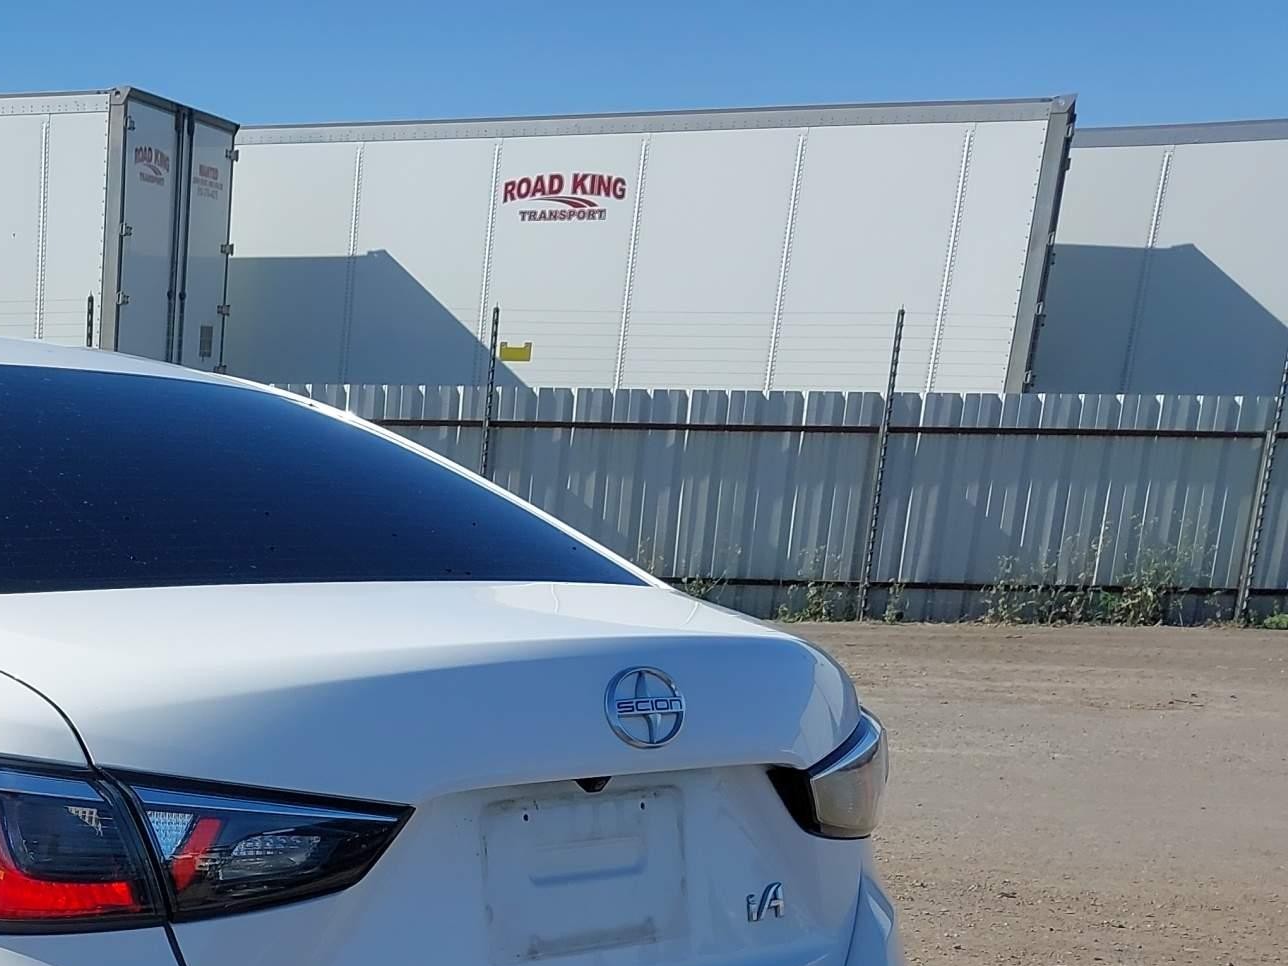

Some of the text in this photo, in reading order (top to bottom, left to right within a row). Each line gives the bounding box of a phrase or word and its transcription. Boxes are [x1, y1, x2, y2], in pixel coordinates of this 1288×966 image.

[503, 173, 627, 203] ROAD KING
[519, 208, 607, 222] TRANSPORT
[746, 881, 784, 922] iA
